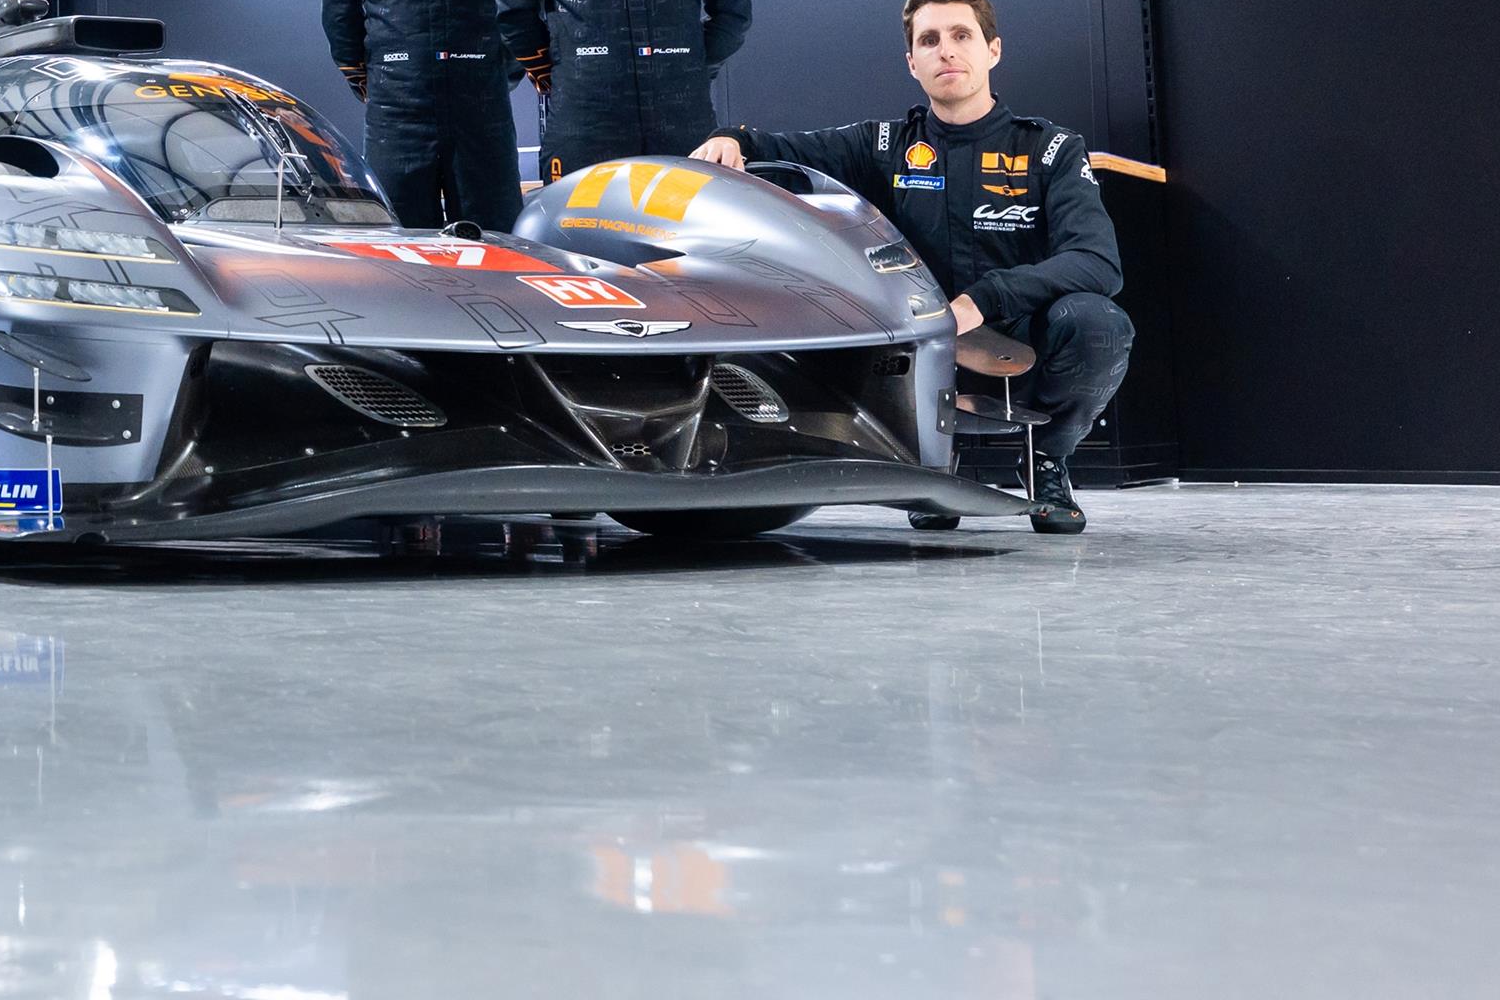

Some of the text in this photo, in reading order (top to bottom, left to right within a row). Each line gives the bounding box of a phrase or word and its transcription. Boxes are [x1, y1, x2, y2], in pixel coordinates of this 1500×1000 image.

[384, 53, 409, 61] sparco
[576, 46, 608, 55] sparco
[1042, 133, 1068, 166] sparco
[973, 204, 1040, 222] WEC
[599, 218, 636, 233] MAGMA
[371, 244, 486, 266] 17
[532, 280, 617, 300] HY
